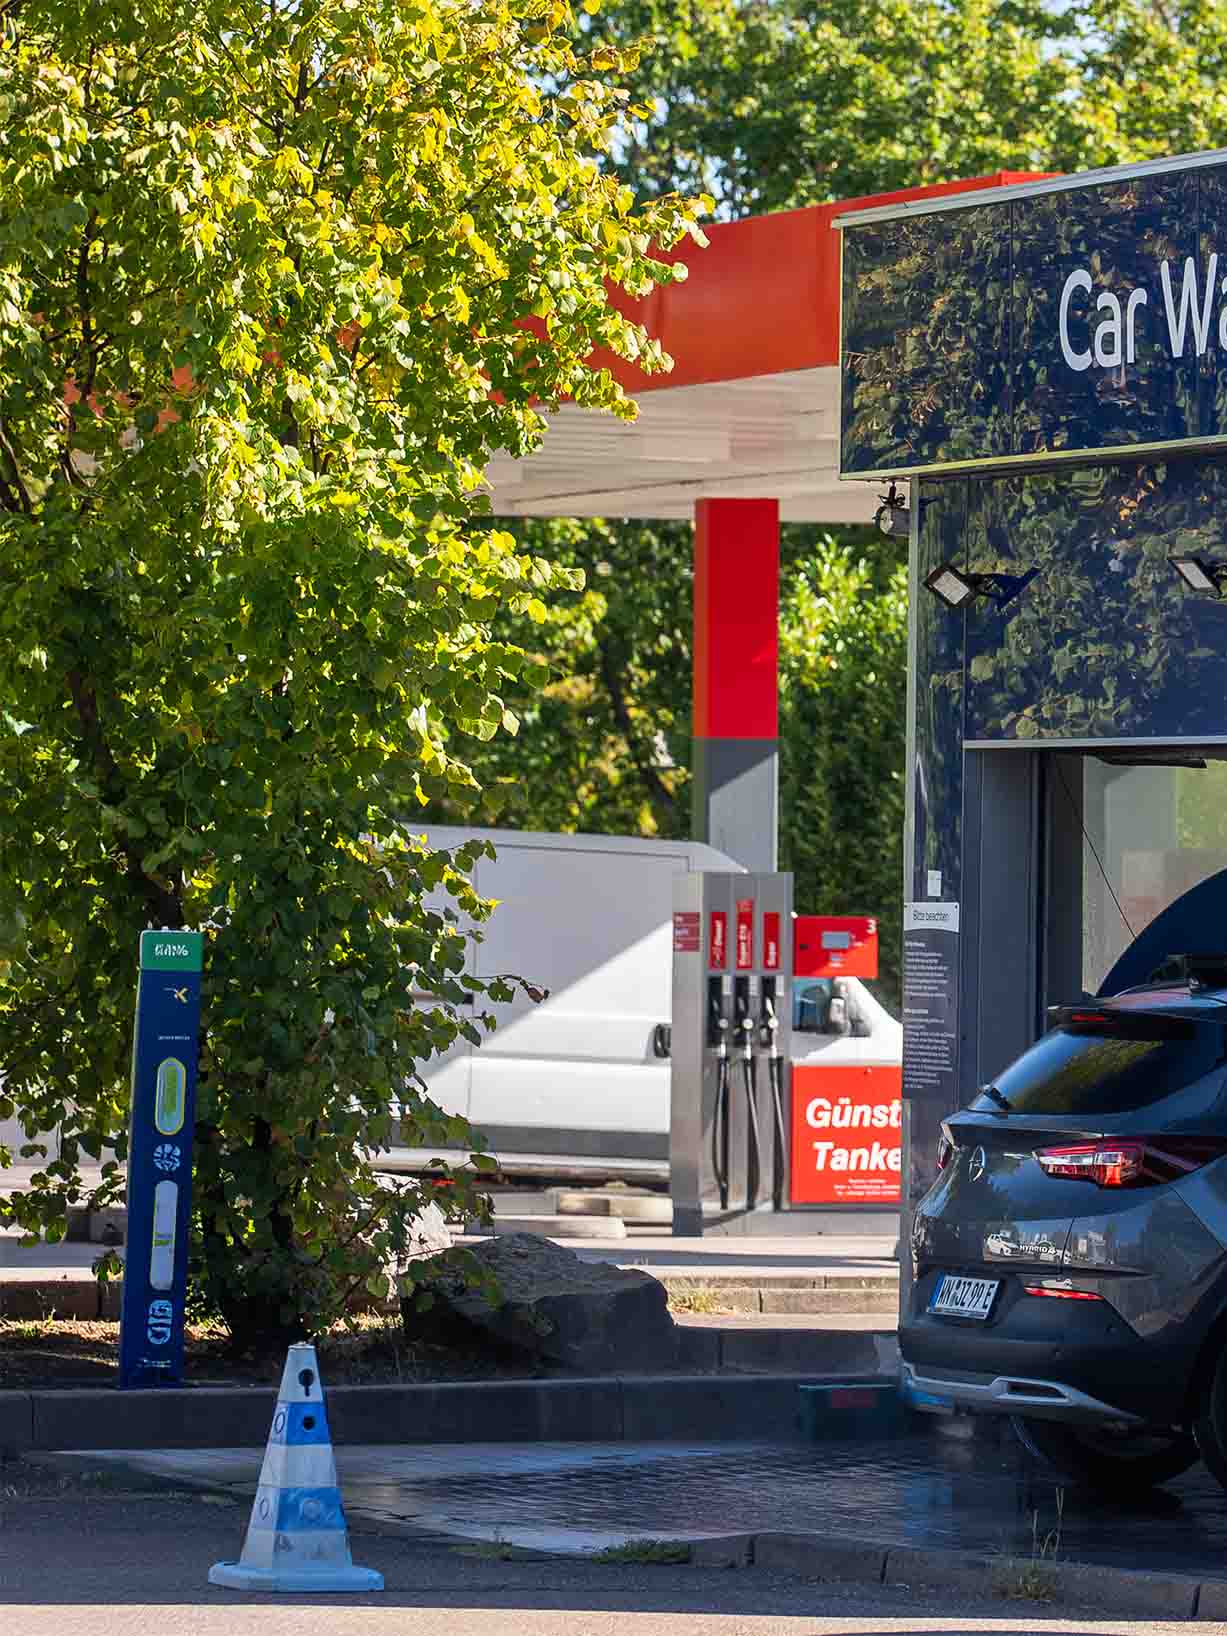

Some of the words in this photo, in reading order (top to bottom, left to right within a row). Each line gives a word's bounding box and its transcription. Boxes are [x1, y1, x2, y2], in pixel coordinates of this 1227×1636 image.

[1059, 269, 1147, 371] Car
[806, 1097, 902, 1128] Günst
[813, 1141, 901, 1171] Tanke
